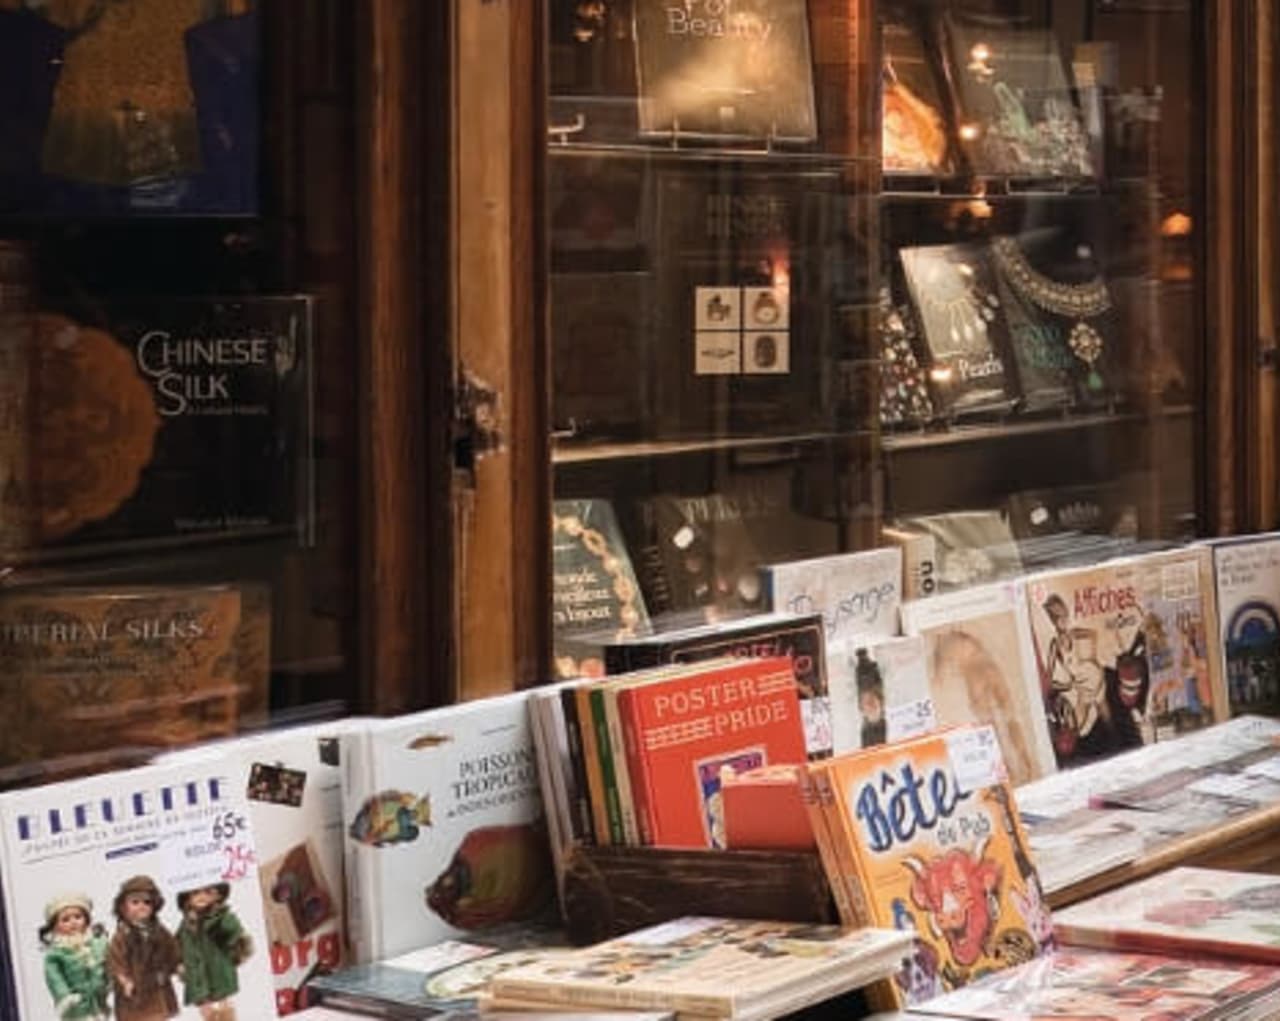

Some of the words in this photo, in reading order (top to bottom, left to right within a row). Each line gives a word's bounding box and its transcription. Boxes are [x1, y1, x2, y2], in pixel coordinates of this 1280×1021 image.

[138, 331, 268, 377] CHINESE
[158, 372, 229, 416] SILK
[1073, 585, 1138, 618] Affiches
[654, 676, 762, 718] POSTER
[714, 700, 788, 736] PRIDE
